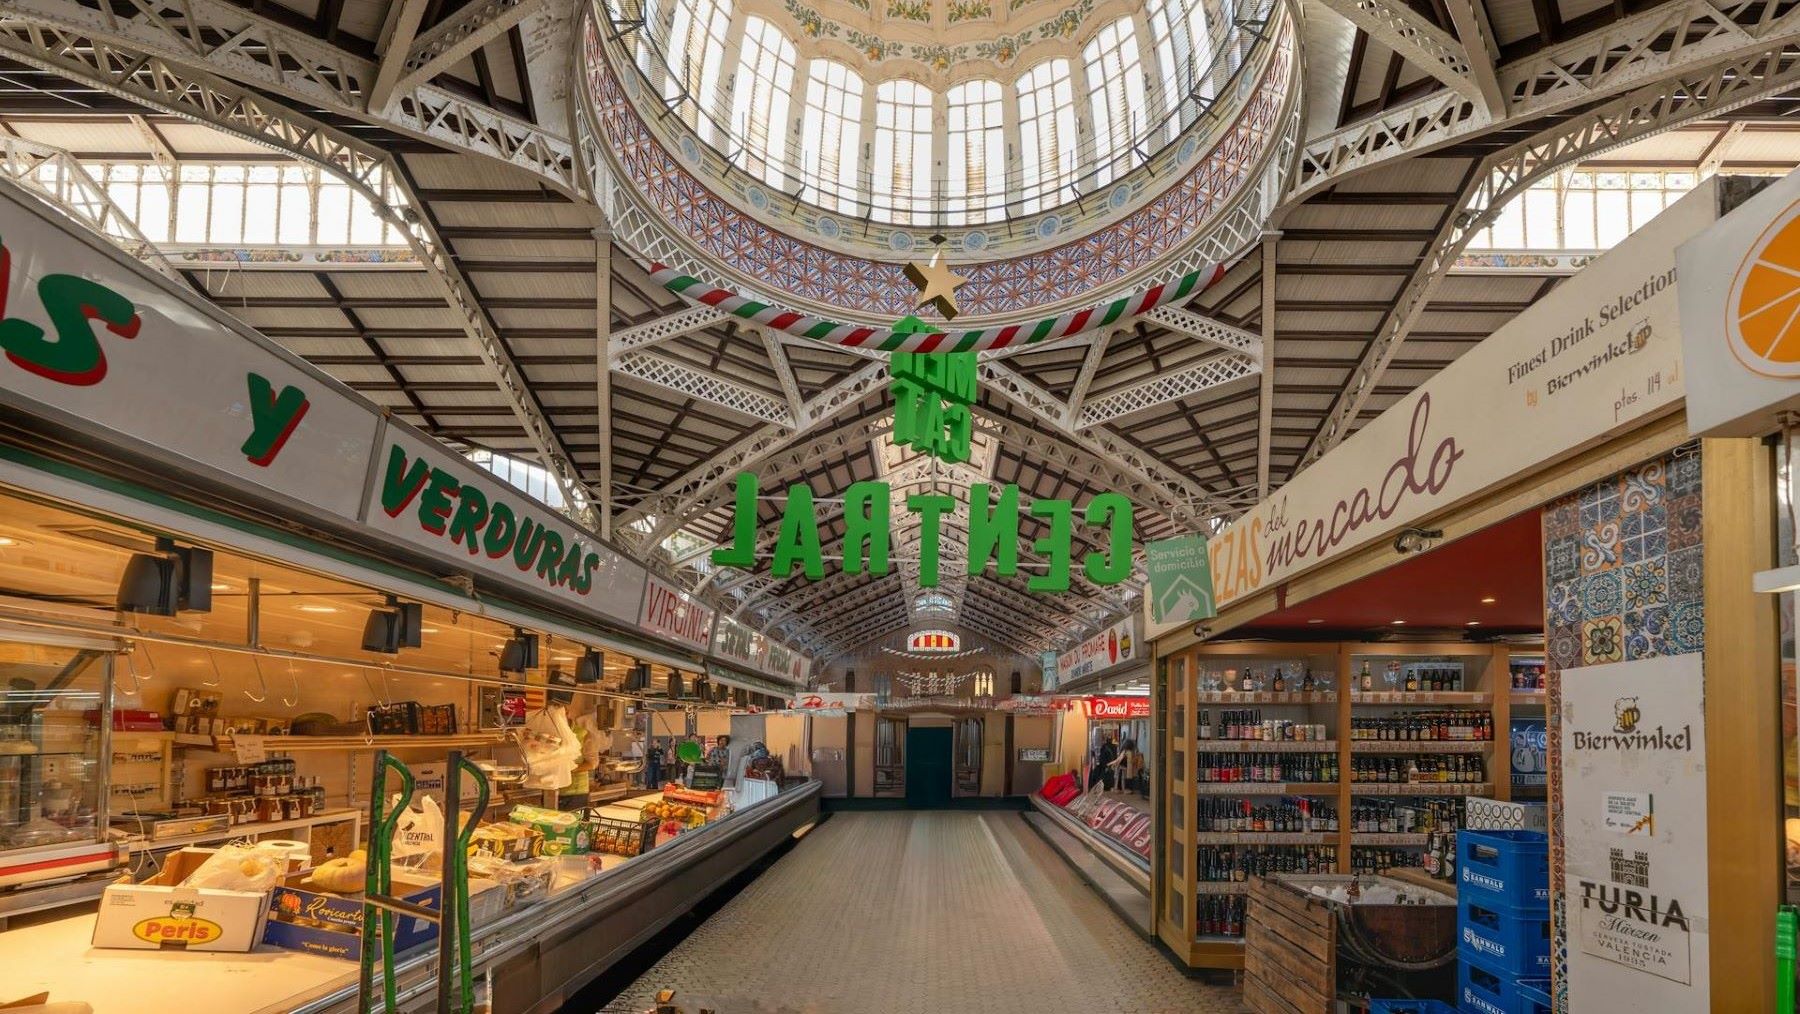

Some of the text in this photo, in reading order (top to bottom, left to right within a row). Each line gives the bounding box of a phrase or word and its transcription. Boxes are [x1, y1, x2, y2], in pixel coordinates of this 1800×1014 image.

[1508, 267, 1678, 385] Finest Drink Selection
[1526, 330, 1634, 406] by Bierwinkel
[1647, 371, 1661, 395] 114
[241, 372, 310, 467] Y
[382, 444, 600, 595] VERDURAS
[1266, 391, 1465, 576] mercado
[1264, 495, 1289, 538] del
[1151, 546, 1195, 561] Servicio
[1154, 558, 1205, 573] domicilio
[648, 582, 709, 646] VIRGINIA
[1095, 699, 1127, 716] David
[1572, 724, 1691, 752] Bierwinkel
[1579, 881, 1690, 932] TURIA
[144, 922, 211, 939] Peris
[1598, 939, 1666, 966] VALENCIA
